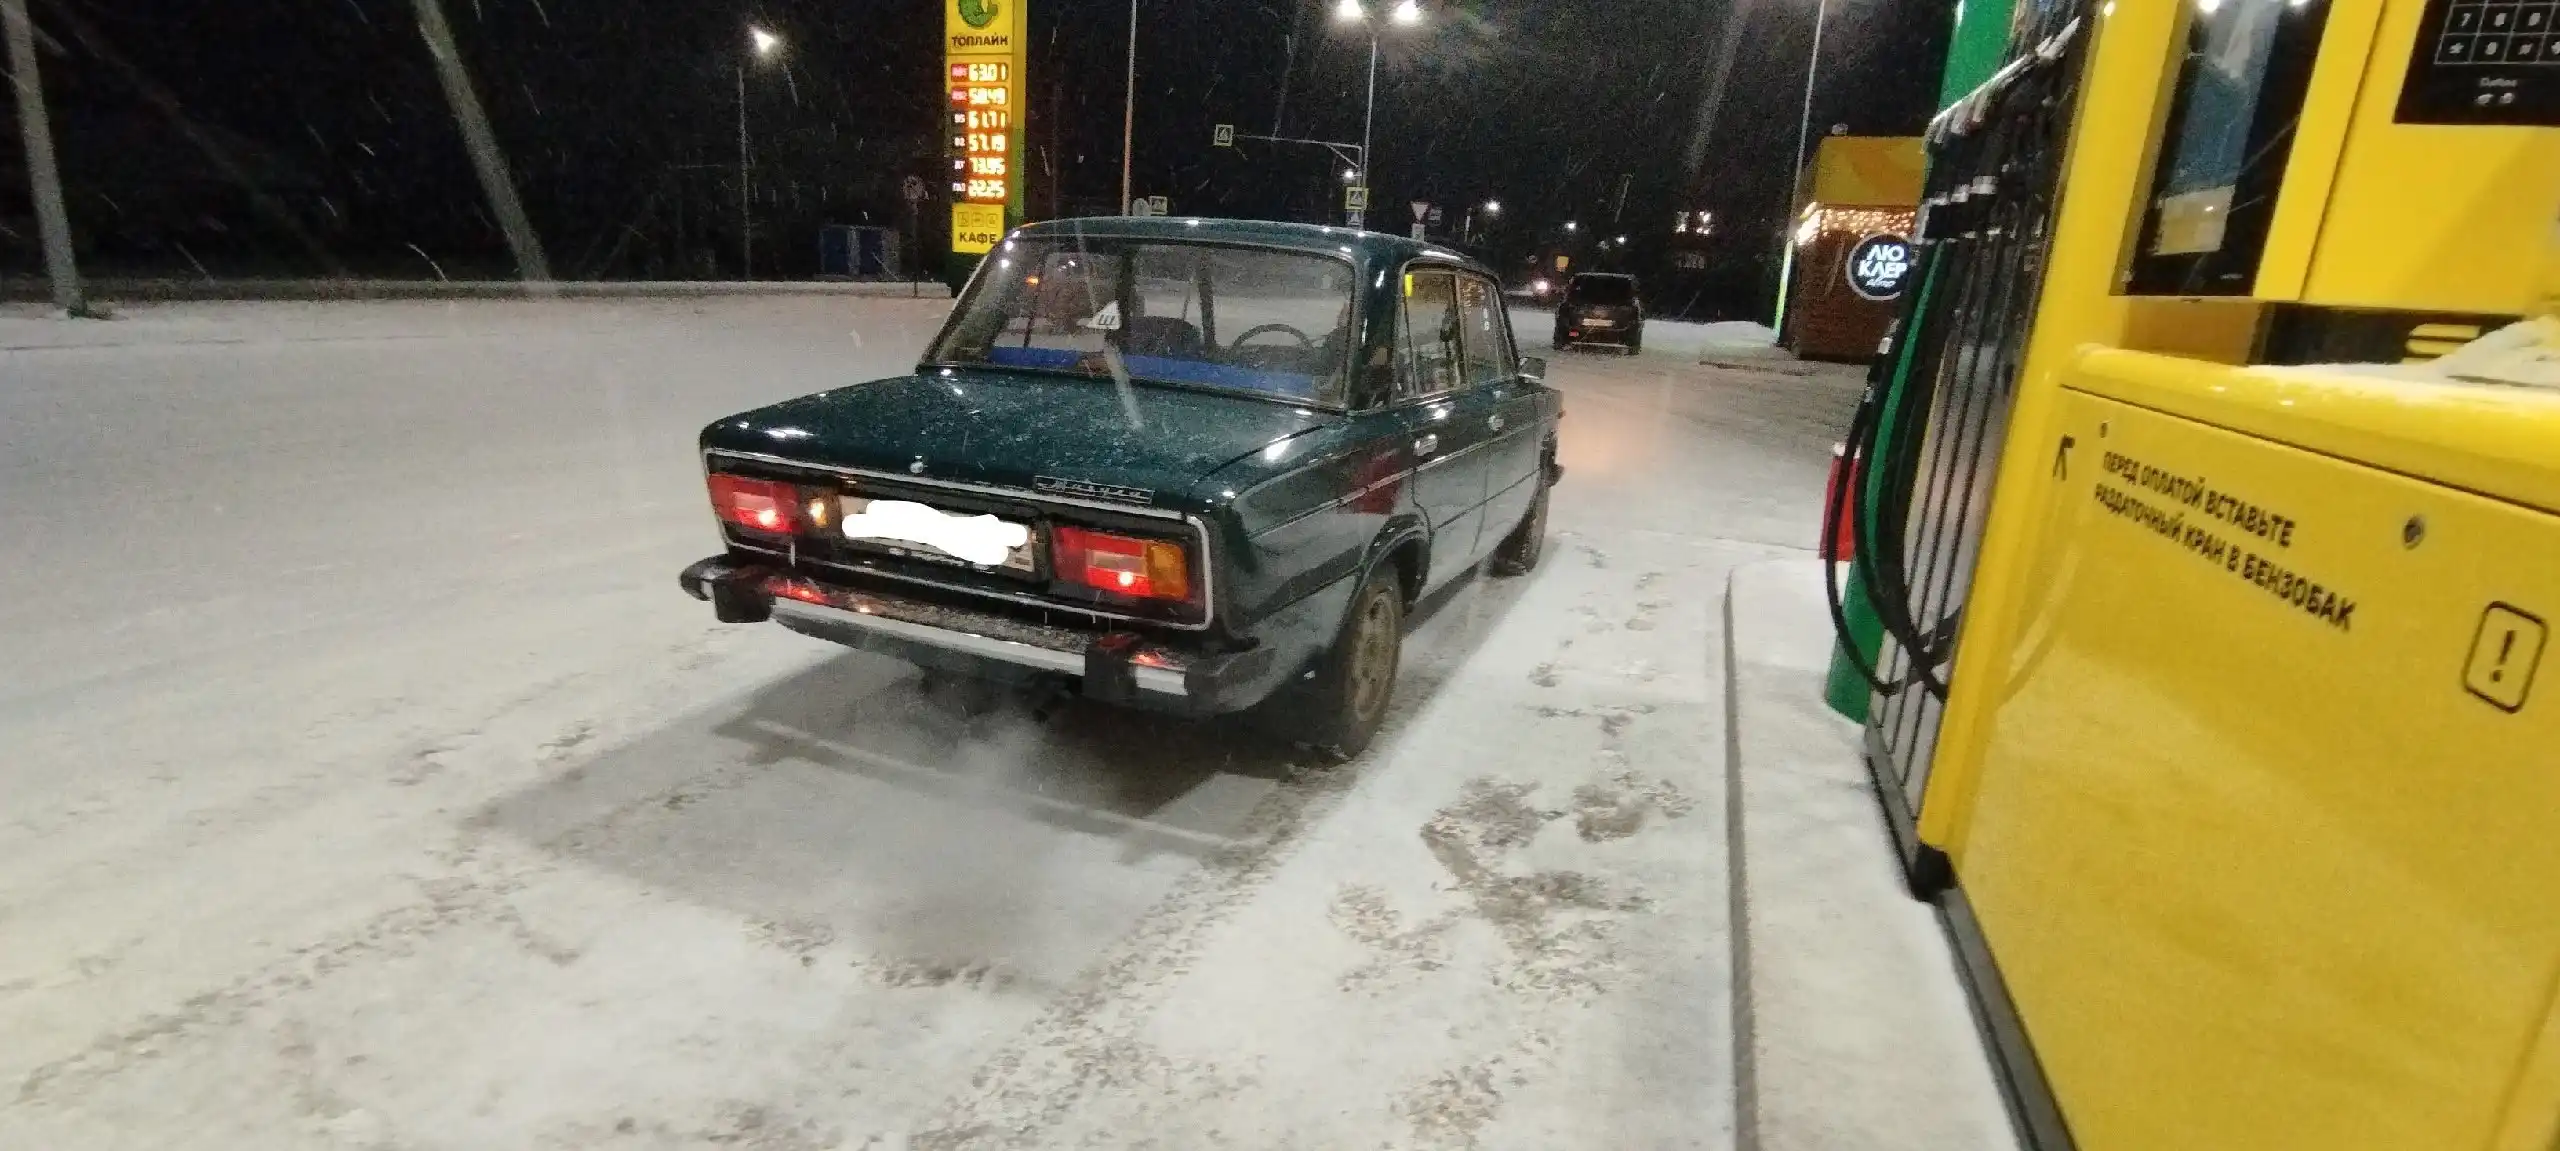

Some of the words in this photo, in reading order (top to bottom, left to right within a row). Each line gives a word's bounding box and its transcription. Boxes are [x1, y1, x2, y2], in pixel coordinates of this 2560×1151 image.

[951, 32, 1008, 46] ТОПЛАЙН
[959, 231, 997, 245] КАФЕ
[1858, 260, 1907, 278] КЛЕР
[2103, 451, 2140, 486] ПЕРЕД
[2140, 466, 2205, 507] ОПЛАТОЙ
[2205, 489, 2296, 548] ВСТАВЬТЕ
[2094, 482, 2184, 543] РАЗДАТОЧНЫЙ
[2183, 524, 2226, 565] КРАН
[2226, 543, 2240, 573] В
[2241, 553, 2357, 633] БЕНЗОБАК
